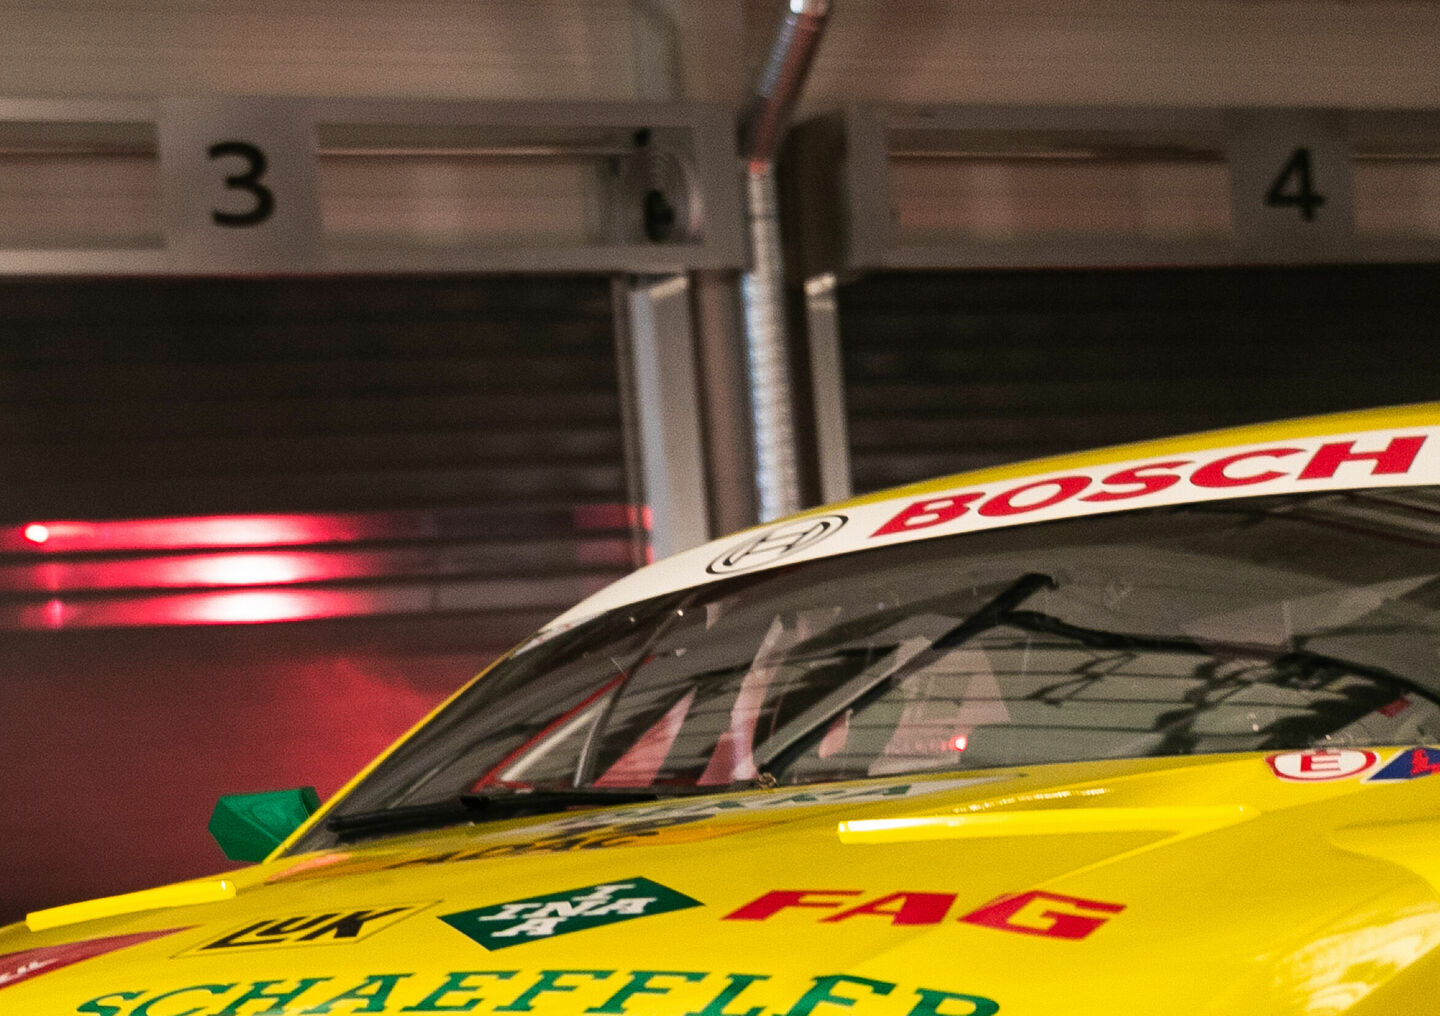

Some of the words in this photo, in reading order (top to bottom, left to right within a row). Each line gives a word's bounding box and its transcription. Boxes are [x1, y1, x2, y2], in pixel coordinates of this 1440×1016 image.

[206, 139, 279, 230] 3
[1264, 148, 1326, 223] 4
[872, 435, 1427, 537] BOSCH
[726, 890, 1123, 939] FAG
